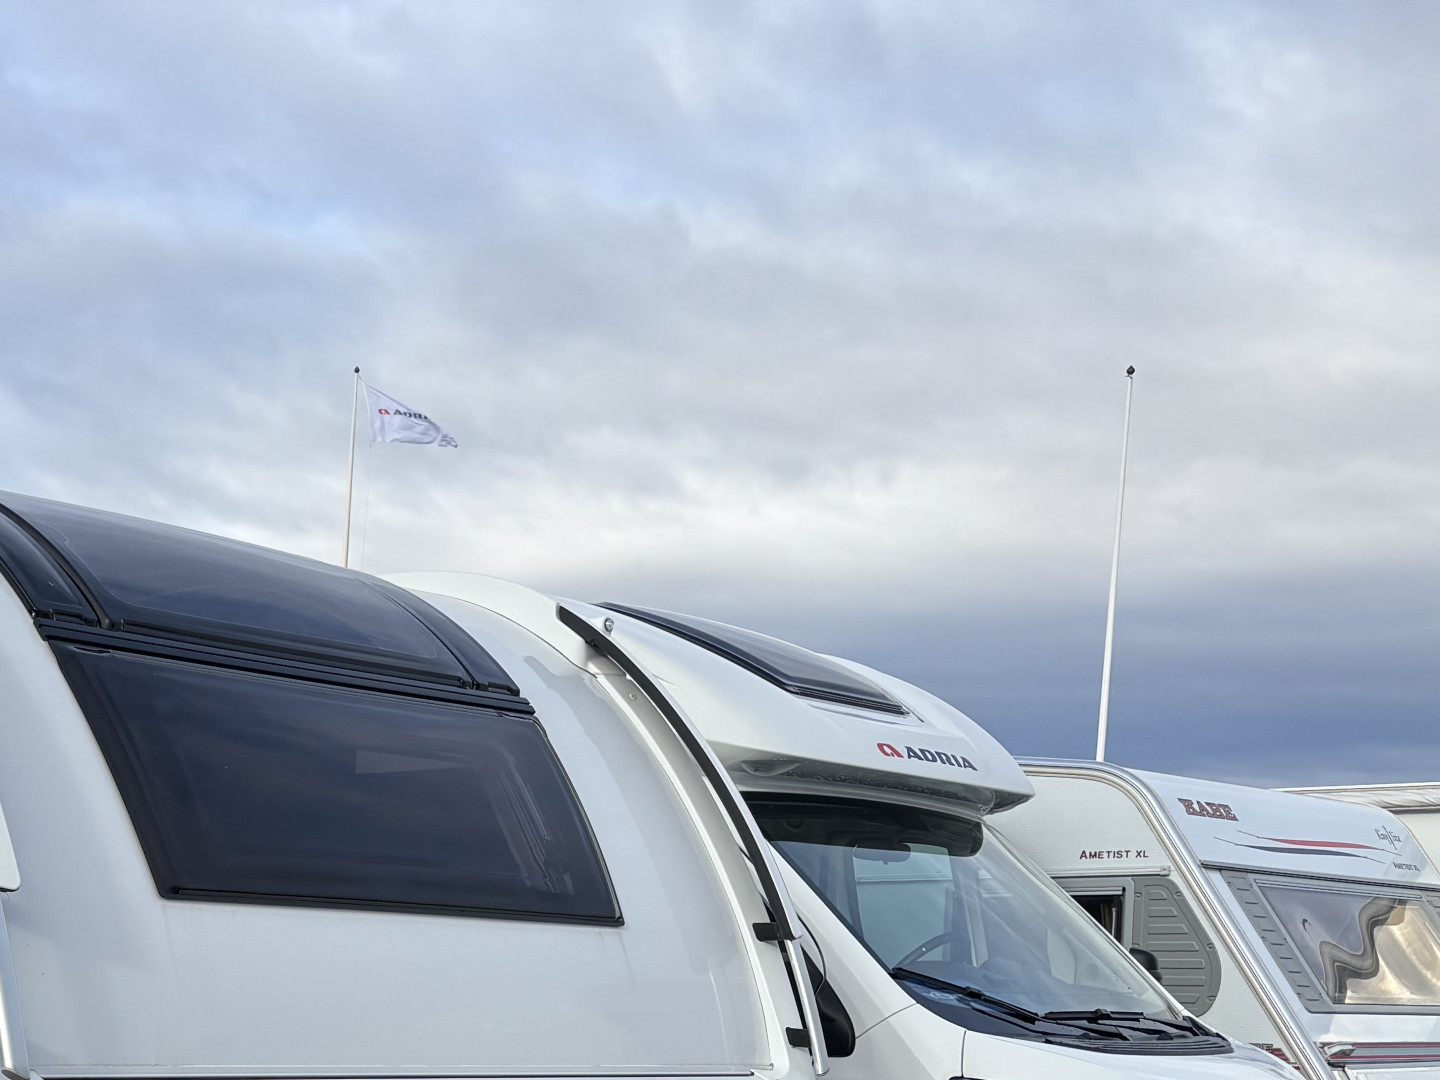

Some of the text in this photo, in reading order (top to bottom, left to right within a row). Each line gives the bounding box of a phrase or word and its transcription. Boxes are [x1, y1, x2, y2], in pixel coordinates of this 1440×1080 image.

[904, 745, 978, 771] ADRIA
[1177, 798, 1239, 821] KABE
[1079, 850, 1149, 859] AMETIST XL
